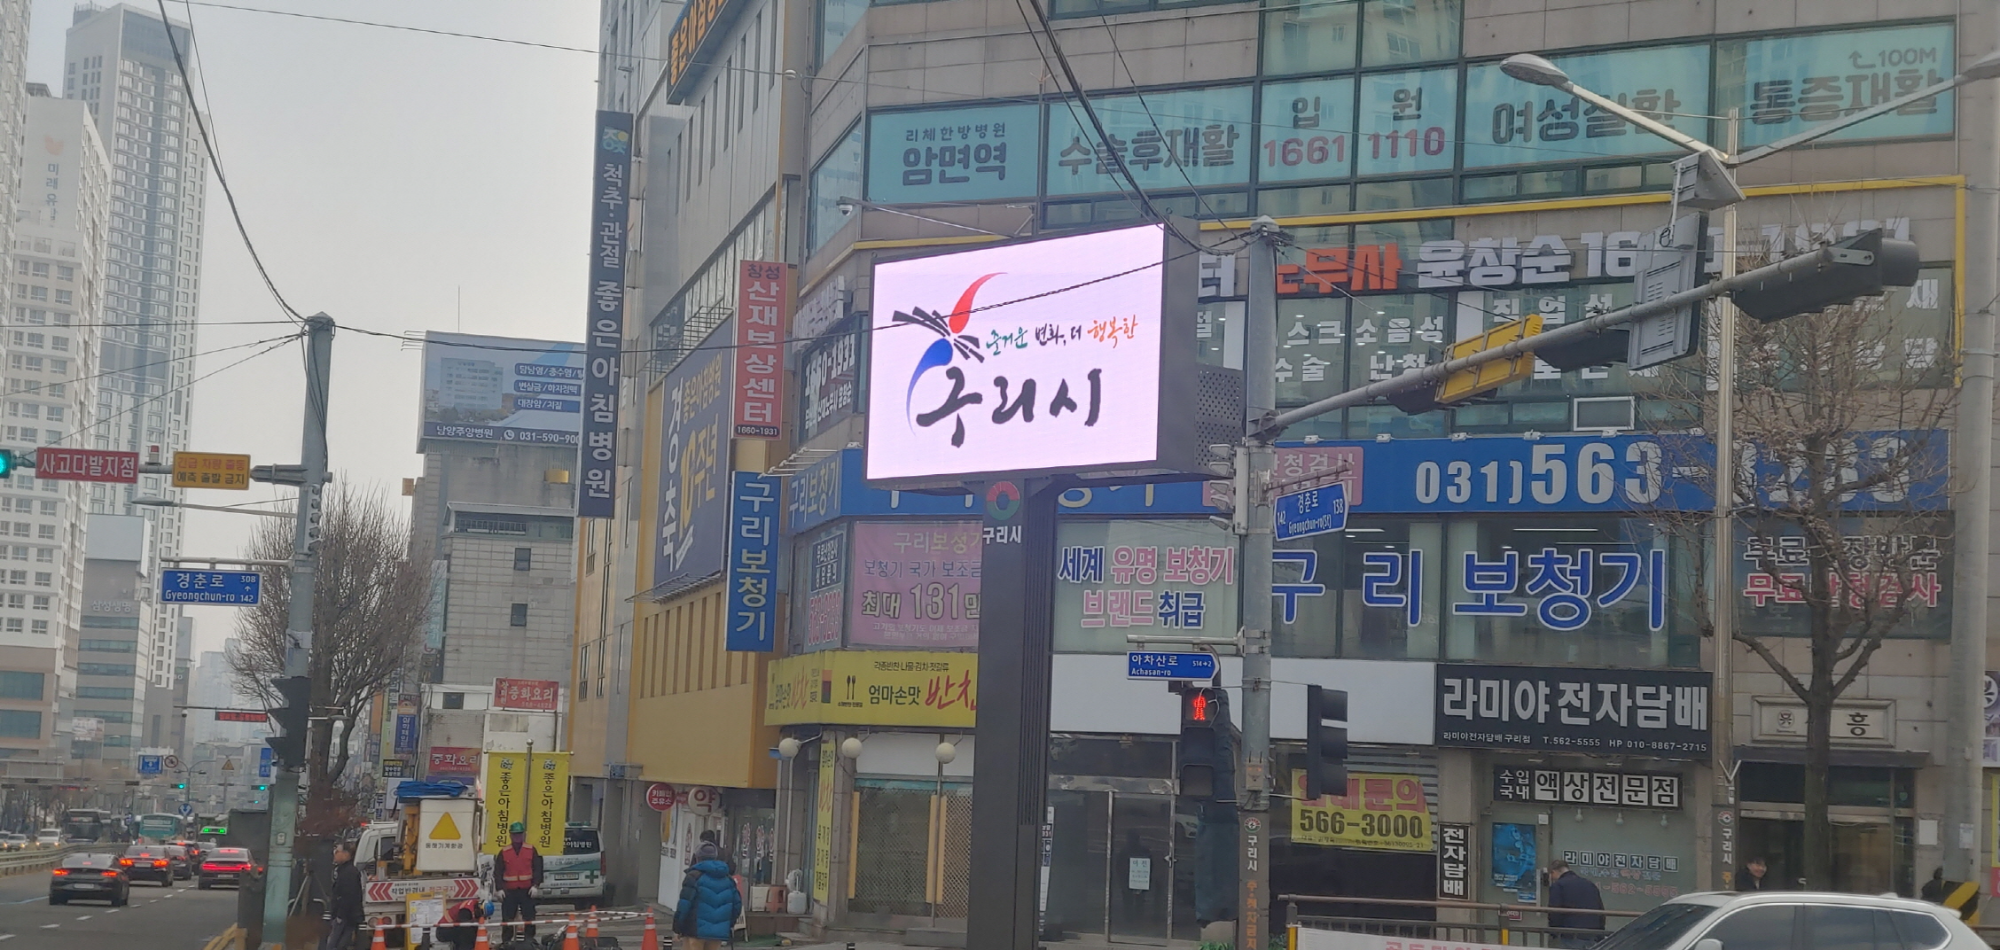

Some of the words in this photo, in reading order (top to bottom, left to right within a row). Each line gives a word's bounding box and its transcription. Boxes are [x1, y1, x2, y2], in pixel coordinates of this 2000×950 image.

[1879, 47, 1937, 67] 100M
[1750, 68, 1944, 125] 통증재활
[905, 122, 1006, 142] 리체한방병원
[1058, 124, 1240, 175] 수술후재활
[1264, 134, 1345, 167] 1661
[1368, 126, 1446, 159] 1110
[902, 142, 1007, 186] 암면역
[747, 263, 781, 281] 창성
[1417, 234, 1573, 289] 윤창순
[985, 327, 1029, 357] 즐거운
[1070, 325, 1082, 340] 더
[1087, 313, 1139, 349] 행복한
[742, 281, 780, 423] 산재보상센터
[585, 281, 623, 499] 좋은아침병원
[915, 366, 1103, 449] 구리시
[436, 425, 494, 439] 남양주양병원
[737, 425, 778, 437] 1660-1931
[39, 454, 136, 479] 사고다발지점
[177, 457, 198, 469] 긴급
[202, 458, 222, 470] 차량
[225, 459, 246, 471] 출동
[224, 473, 245, 485] 금지
[789, 456, 840, 529] 구리보청기
[1297, 490, 1319, 514] 경춘로
[1277, 510, 1287, 526] 142
[982, 524, 1022, 544] 구리시
[735, 482, 775, 641] 구리보청기
[909, 561, 936, 578] 국가
[1057, 546, 1104, 583] 세계
[1111, 546, 1157, 584] 유명
[1163, 546, 1234, 584] 보청기
[176, 572, 225, 589] 경춘로
[241, 575, 257, 584] 308
[1452, 547, 1666, 632] 보청기
[165, 589, 235, 603] Gyeongchun-ro
[240, 594, 254, 603] 142
[861, 590, 901, 619] 최대
[1080, 590, 1154, 628] 브랜드
[1158, 590, 1205, 629] 취급
[1131, 654, 1179, 667] 아차산로
[1131, 667, 1172, 677] Achasan-ro
[508, 685, 555, 702] 중화요리
[868, 685, 921, 706] 엄마손맛
[1443, 678, 1550, 724] 라미야
[1557, 681, 1708, 731] 전자담배
[1443, 731, 1503, 743] 라미야전자담배
[1504, 733, 1531, 744] 구리점
[1543, 736, 1601, 747] T.562-5555
[1609, 739, 1624, 748] HP
[1627, 739, 1707, 752] 010-8867-2715
[431, 753, 480, 766] 중화요리
[1500, 769, 1530, 784] 수입
[1500, 785, 1530, 800] 국내
[1535, 770, 1679, 807] 액상전문점
[496, 772, 512, 848] 좋은아침병원
[539, 772, 555, 848] 좋은아침병원
[694, 790, 716, 813] 약
[1300, 808, 1424, 839] 566-3000
[1247, 835, 1258, 872] 구리시
[1723, 828, 1733, 865] 구리시
[1442, 827, 1467, 896] 전자담배
[1563, 850, 1679, 872] 라미야전자담배
